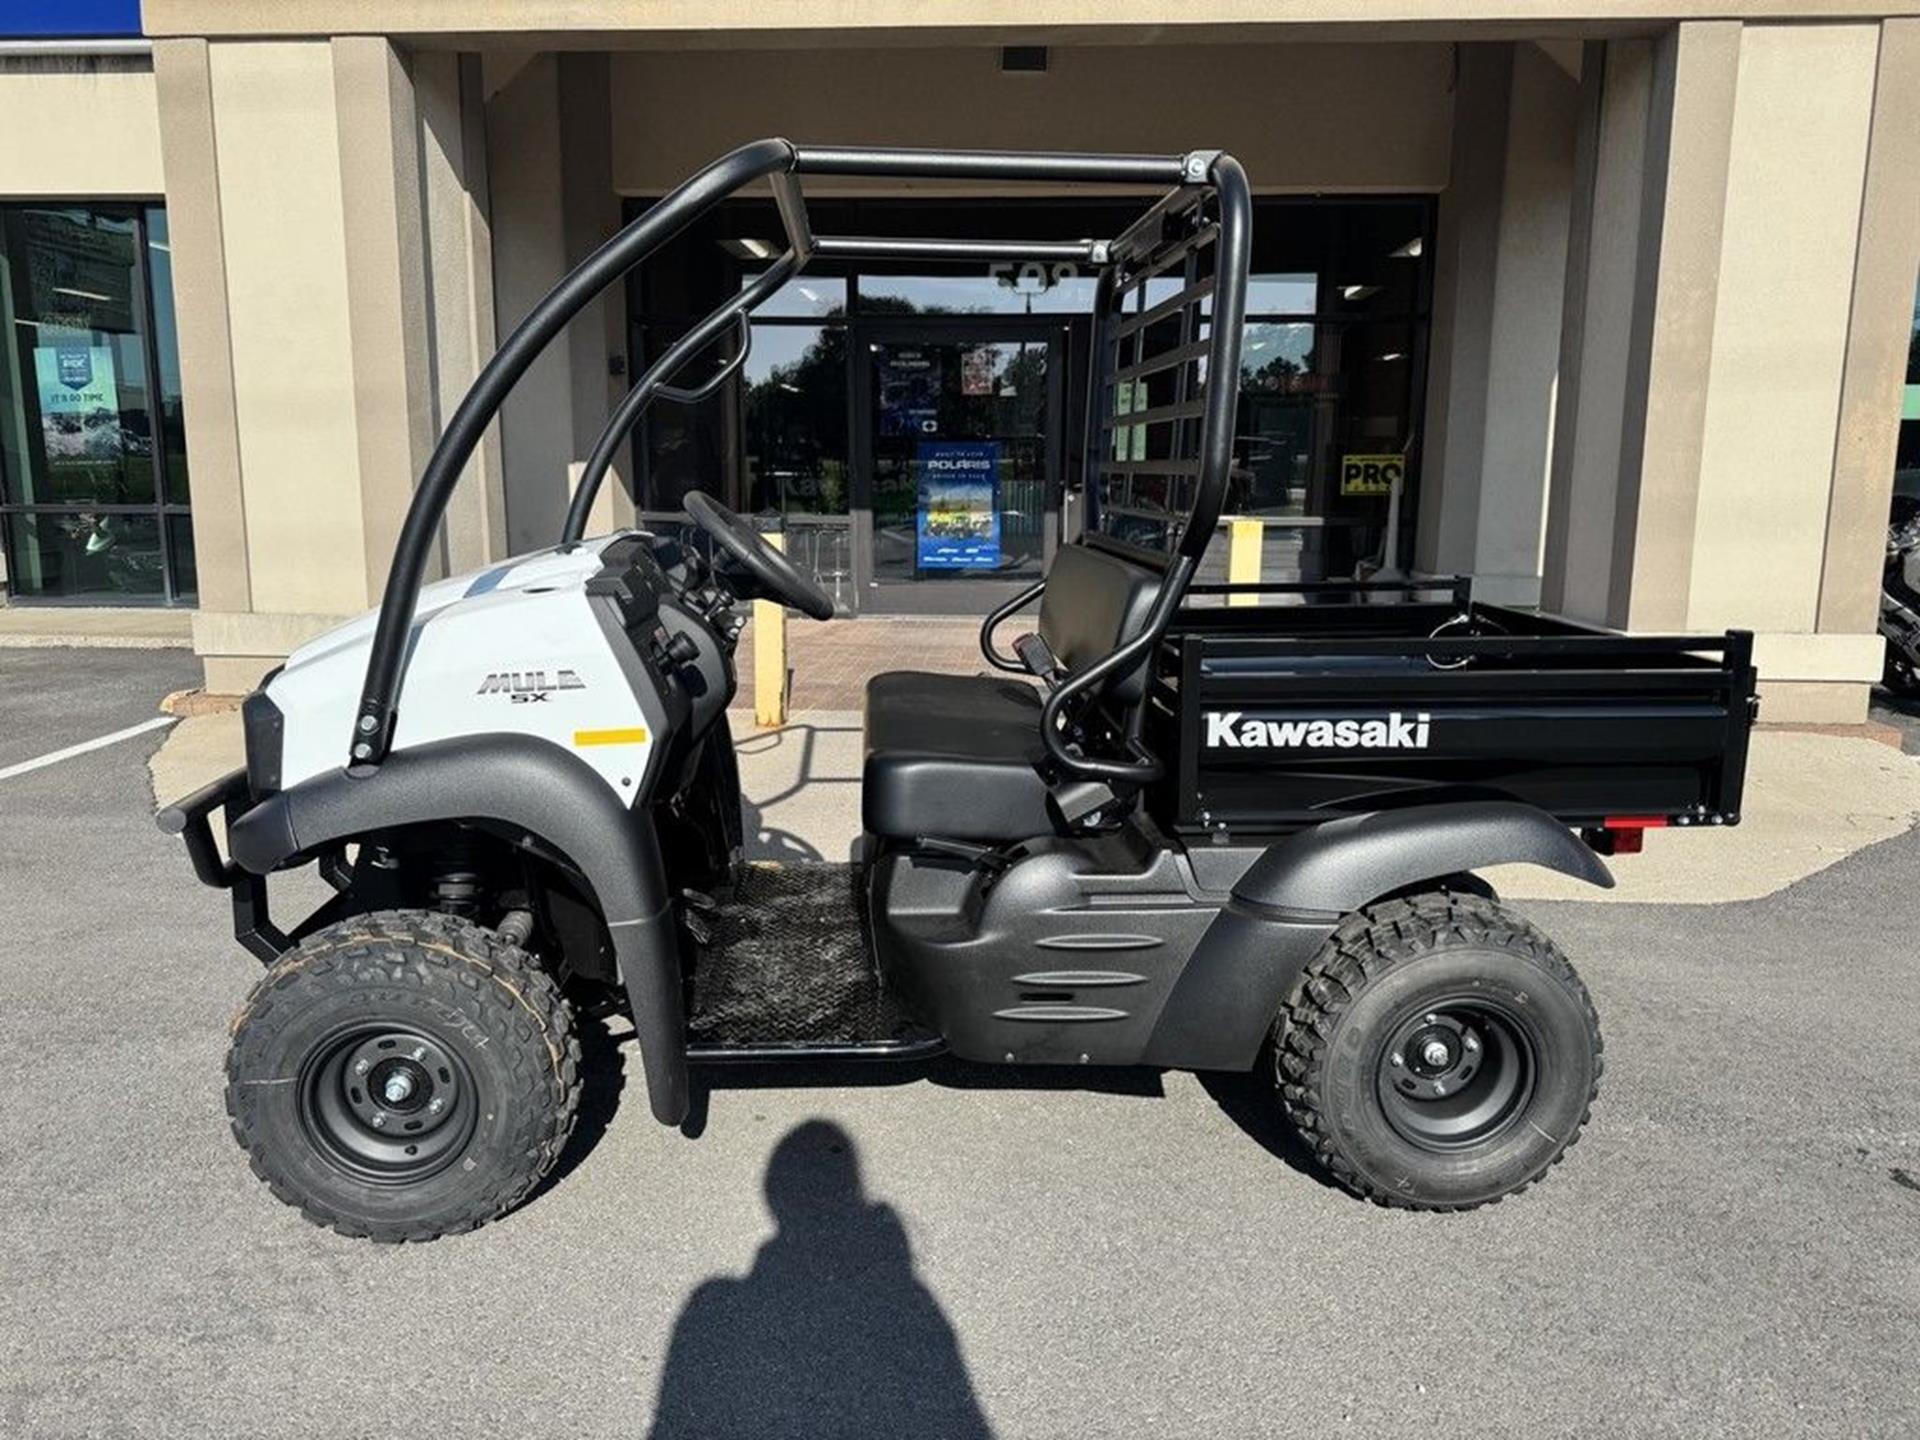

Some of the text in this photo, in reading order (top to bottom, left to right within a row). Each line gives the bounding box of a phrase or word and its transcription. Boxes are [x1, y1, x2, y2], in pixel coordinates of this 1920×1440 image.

[927, 459, 991, 470] POLARIS
[1345, 463, 1401, 485] PRO
[511, 692, 549, 703] SX
[1206, 711, 1430, 749] Kawasaki
